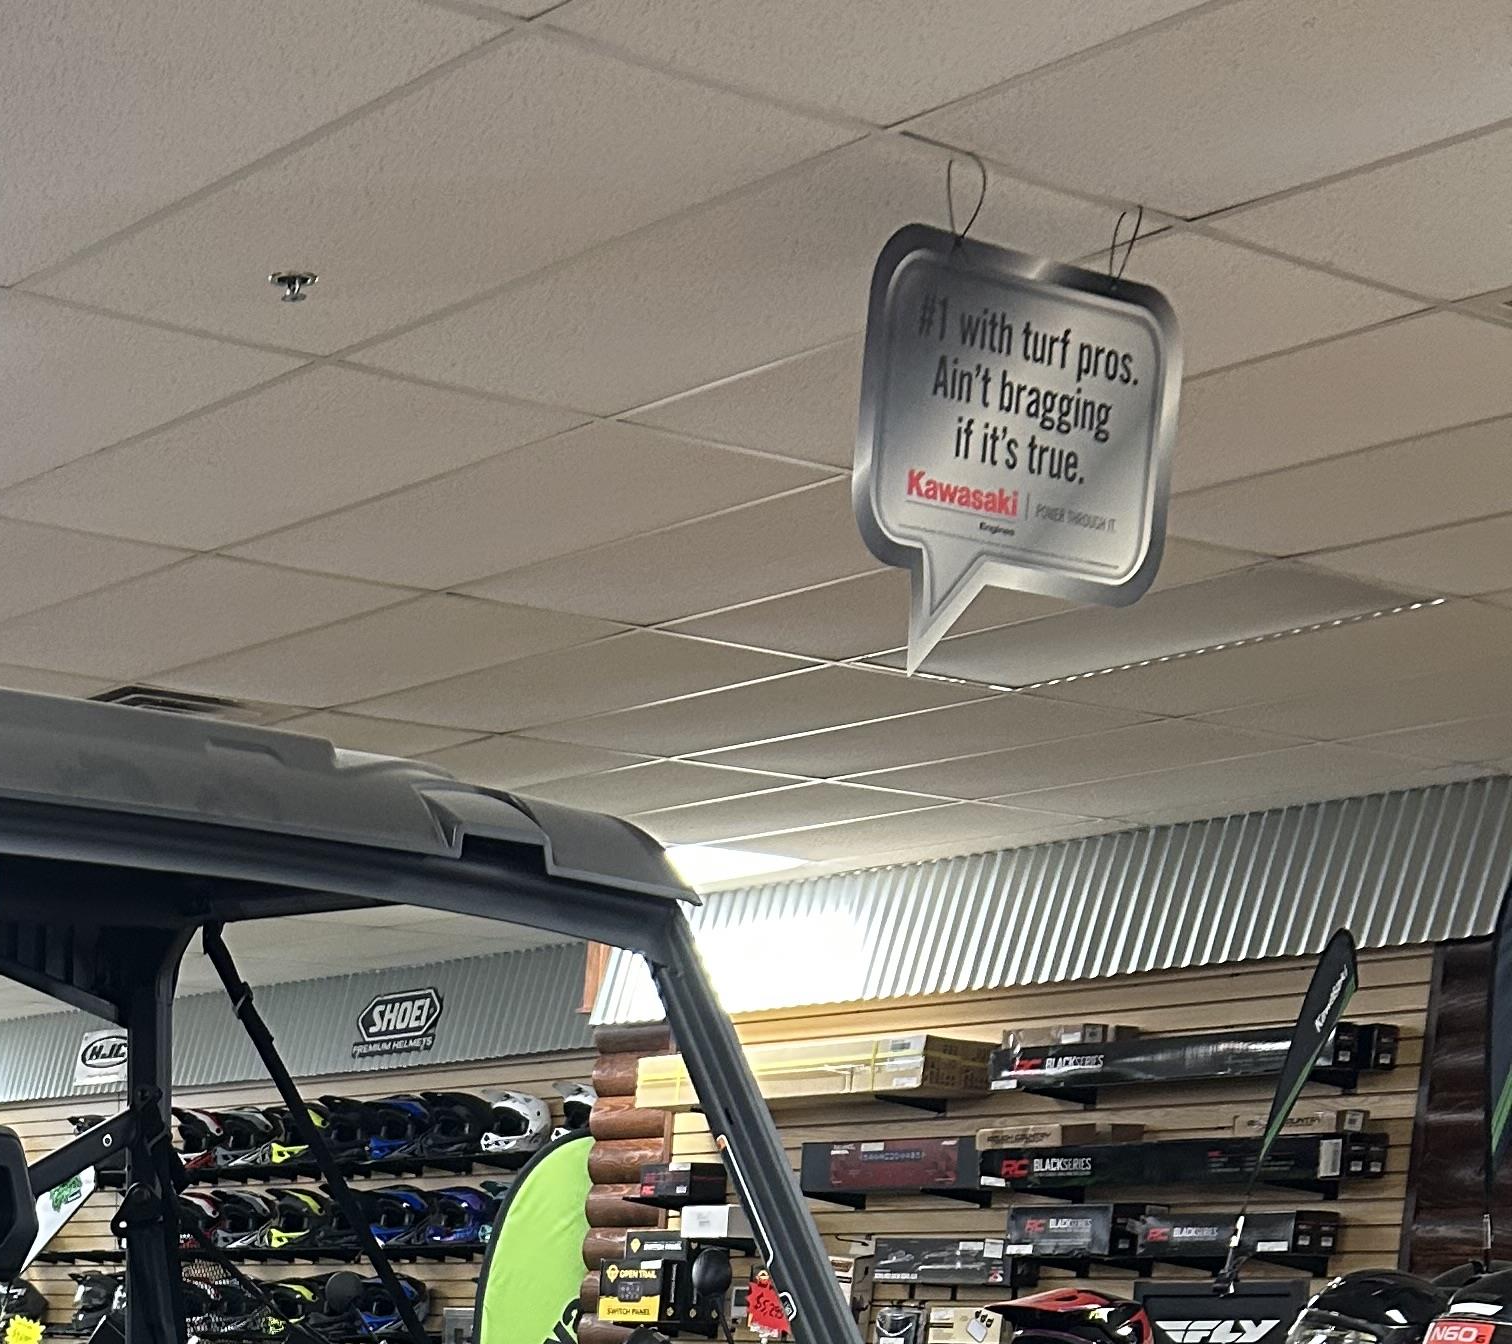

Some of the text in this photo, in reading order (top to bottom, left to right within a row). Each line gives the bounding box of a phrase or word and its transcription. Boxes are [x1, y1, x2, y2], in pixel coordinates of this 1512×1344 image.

[919, 295, 1139, 387] #1 with turf pros.
[932, 354, 1113, 443] Ain't bragging
[954, 416, 1085, 485] if it's true.
[906, 468, 1019, 518] Kawasaki
[369, 997, 432, 1034] SHOEI
[88, 1042, 128, 1061] HJC
[352, 1036, 433, 1057] PREMIUM HELMETS
[1155, 1318, 1282, 1344] FLY
